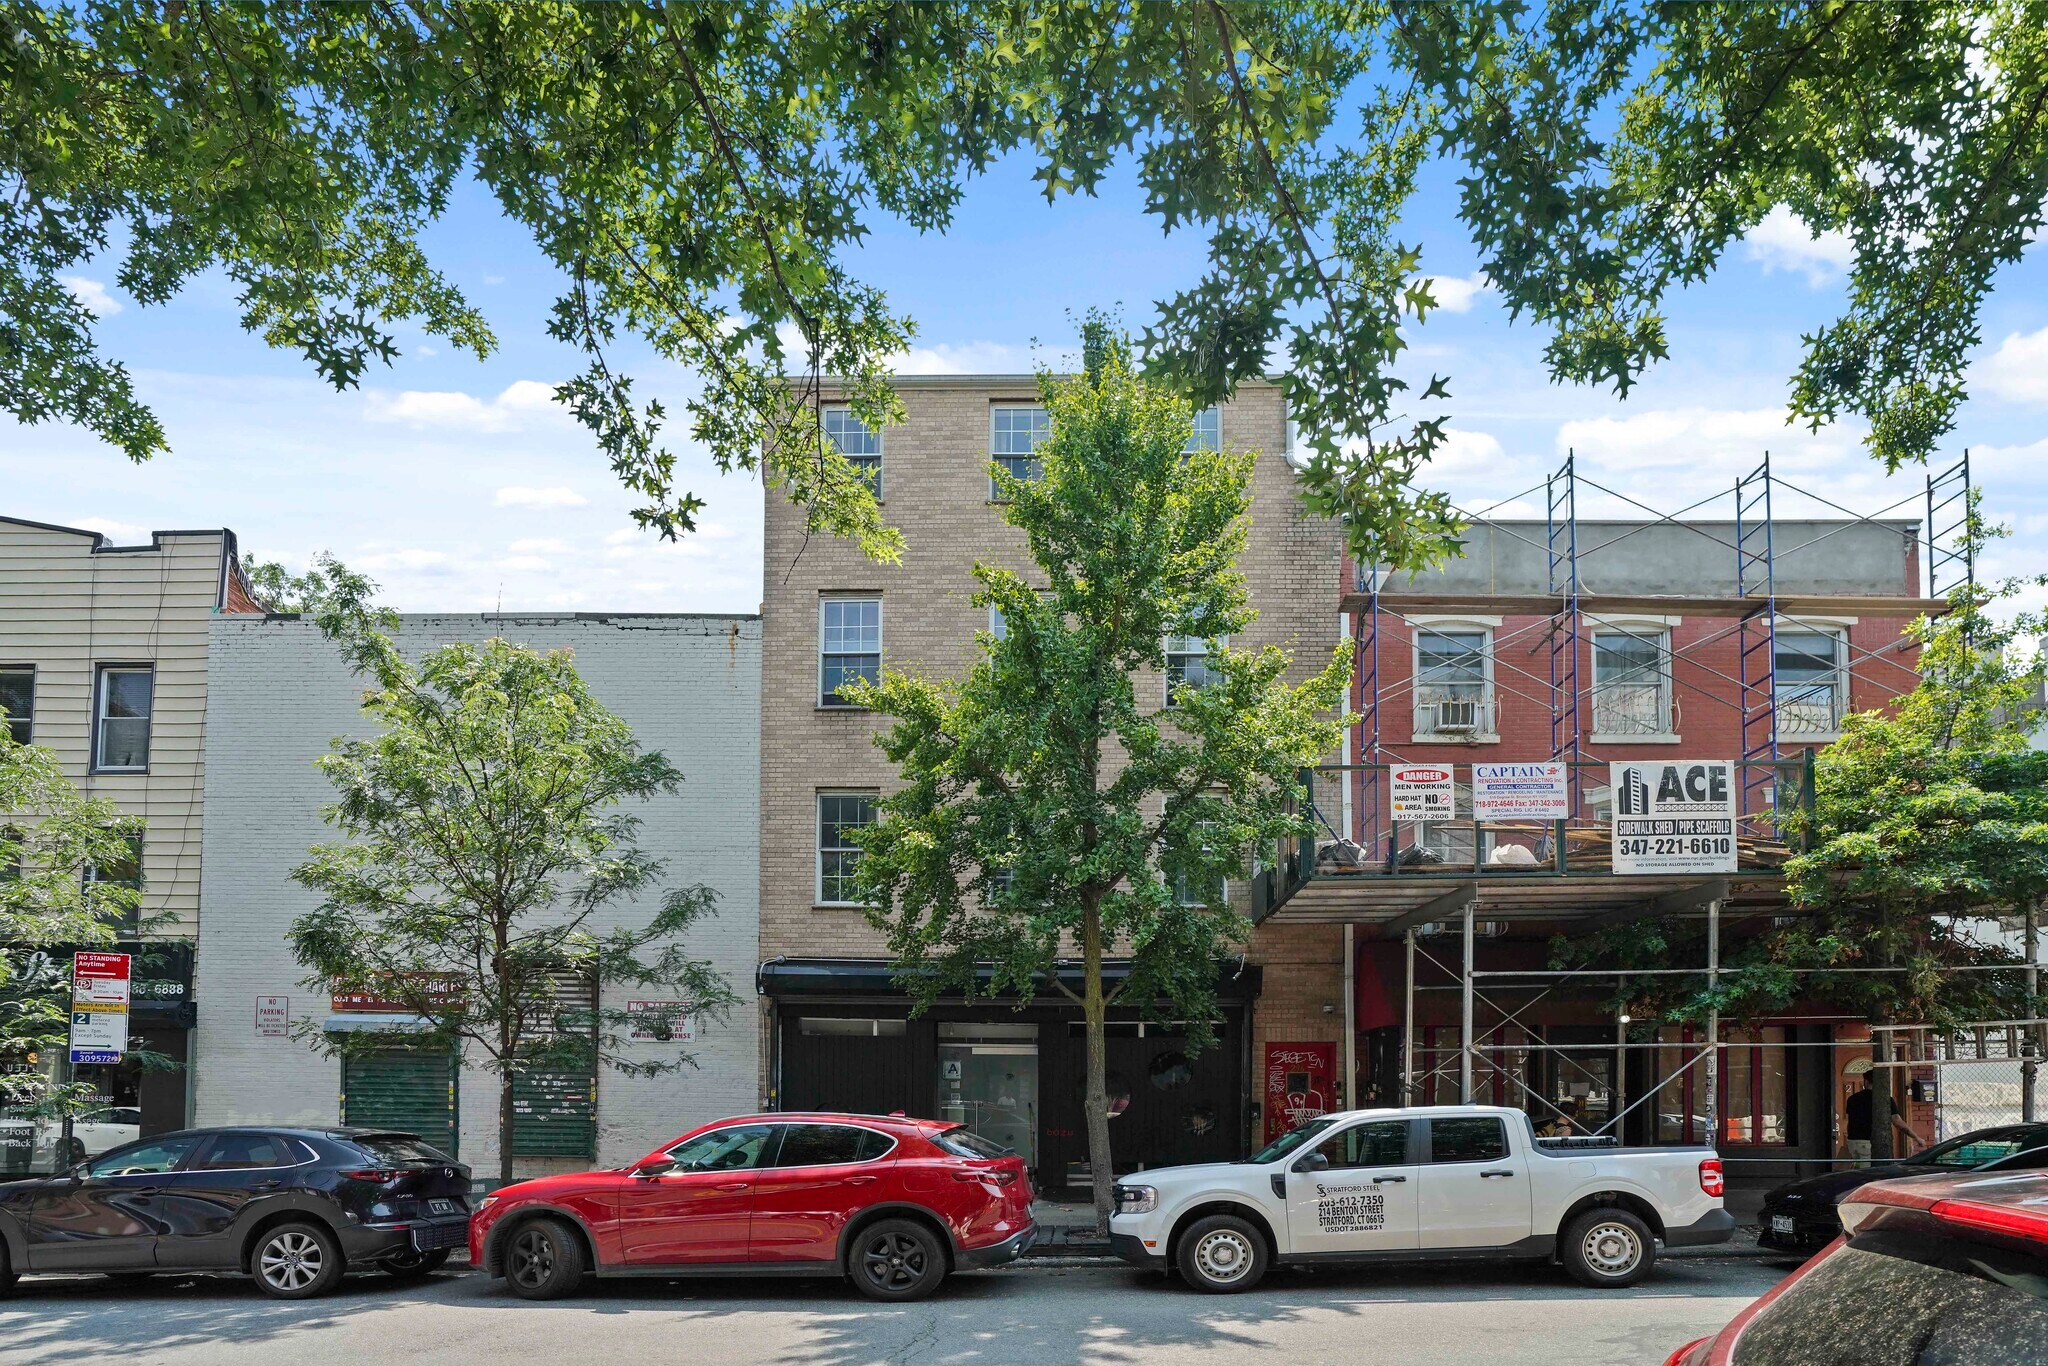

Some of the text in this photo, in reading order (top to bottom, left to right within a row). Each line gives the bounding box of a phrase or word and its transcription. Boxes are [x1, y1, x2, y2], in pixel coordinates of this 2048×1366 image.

[1403, 772, 1442, 780] DANGER
[1477, 766, 1544, 777] CAPTAIN
[1656, 765, 1728, 802] ACE
[1425, 794, 1438, 804] NO
[1475, 800, 1513, 808] 718-972-4646
[1619, 820, 1730, 835] SIDEWALK SHED PIPE SCAFFOLD
[1620, 838, 1730, 855] 347-221-6610
[630, 1003, 644, 1011] NO
[77, 1013, 86, 1024] 2
[948, 1064, 958, 1074] A
[74, 1094, 115, 1103] Massage
[9, 1128, 31, 1136] Foot
[8, 1139, 31, 1147] Back
[1318, 1195, 1384, 1207] 203-612-7350
[1319, 1205, 1383, 1217] 214 BENTON STREET
[1319, 1214, 1384, 1226] STRATFORD, CT 06615
